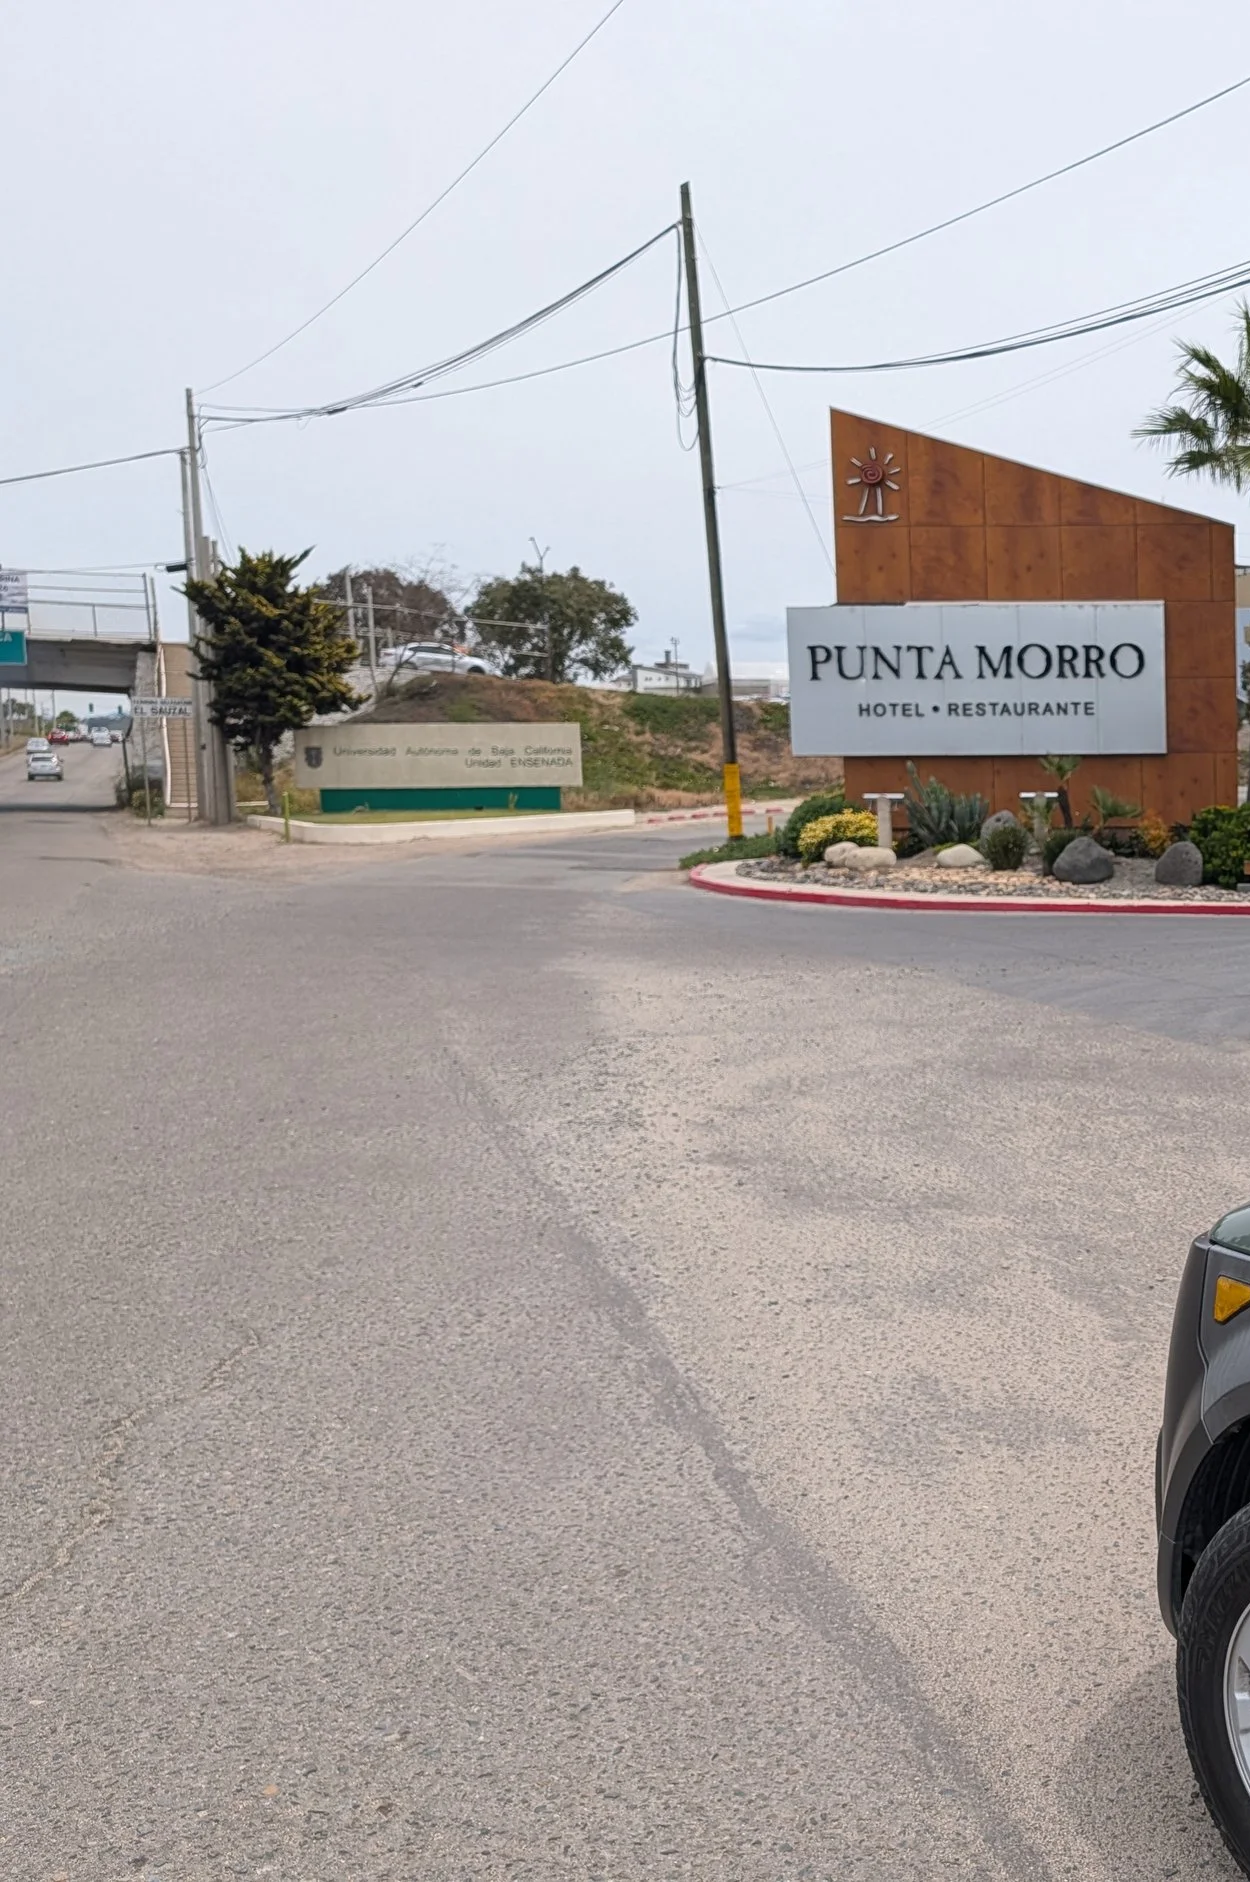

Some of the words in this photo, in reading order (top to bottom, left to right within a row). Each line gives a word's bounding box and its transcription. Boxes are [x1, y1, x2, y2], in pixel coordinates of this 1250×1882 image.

[807, 644, 963, 681] PUNTA
[975, 643, 1145, 680] MORRO
[134, 705, 148, 716] EL
[151, 705, 192, 716] SAUZAL
[859, 702, 925, 718] HOTEL
[948, 701, 1096, 717] RESTAURANTE
[333, 746, 397, 756] Universidad
[468, 747, 482, 756] de
[491, 746, 515, 757] Baja
[524, 745, 573, 756] California
[465, 758, 502, 769] Unidad
[510, 757, 573, 768] ENSENADA
